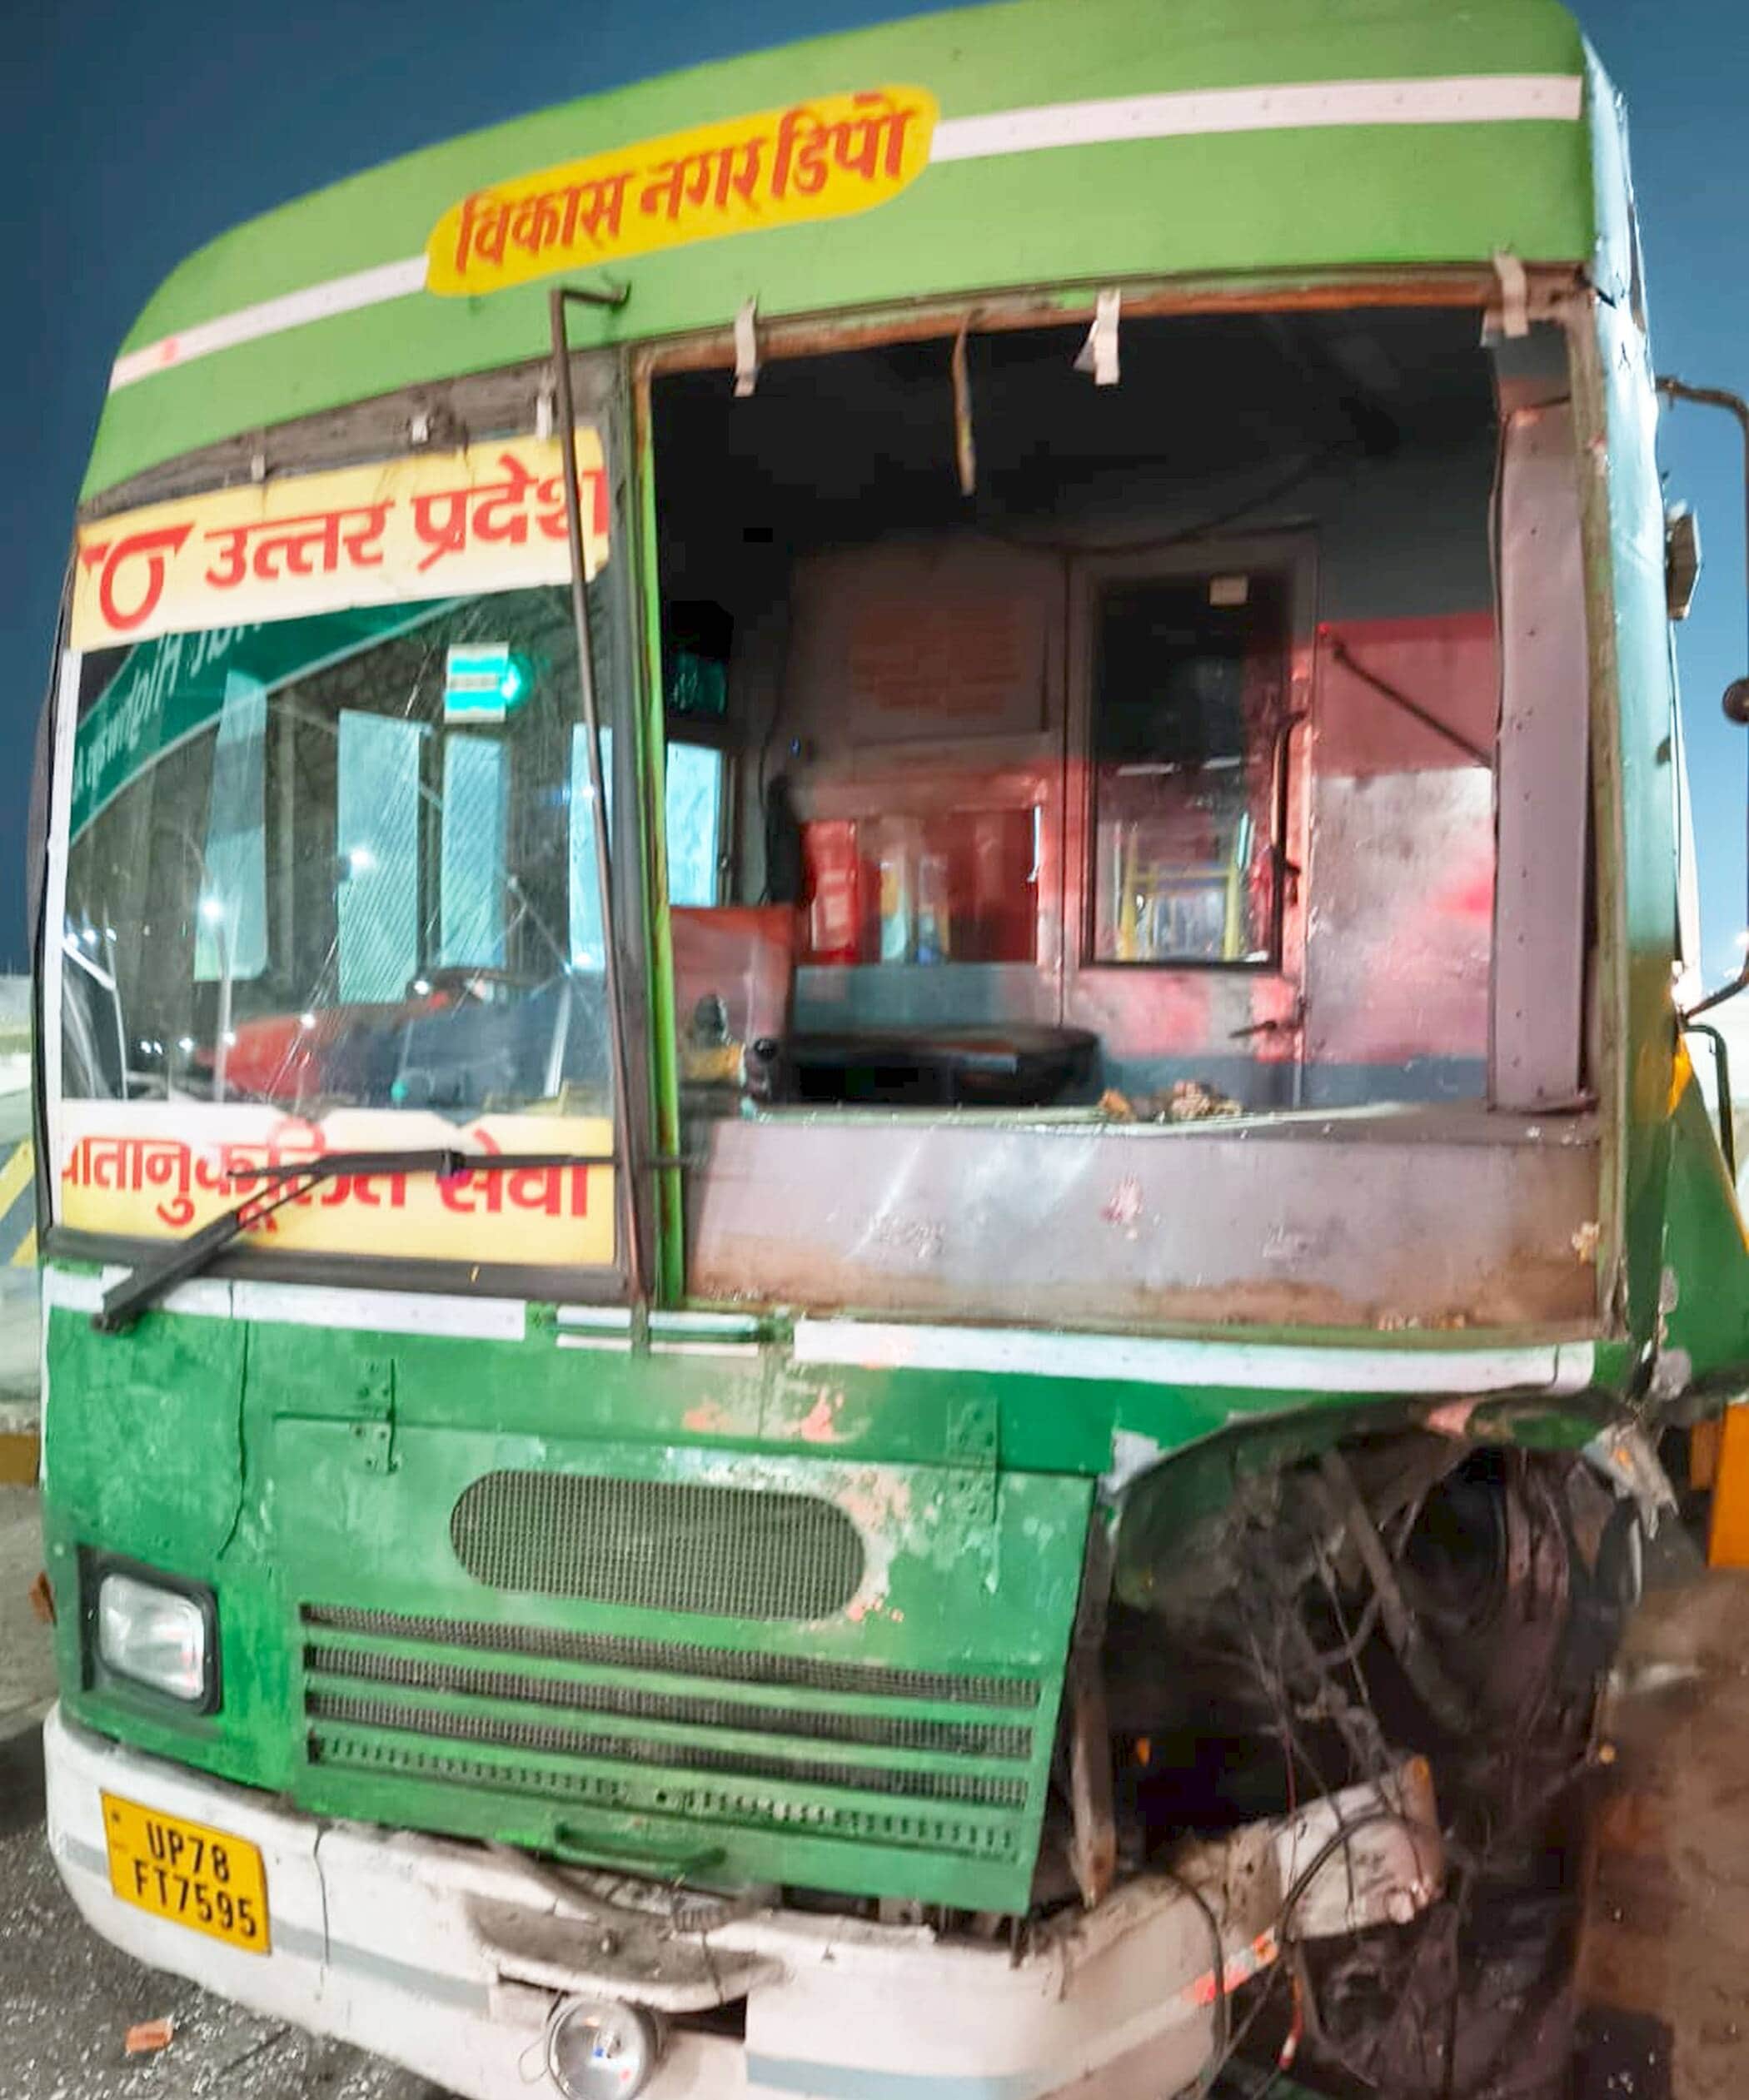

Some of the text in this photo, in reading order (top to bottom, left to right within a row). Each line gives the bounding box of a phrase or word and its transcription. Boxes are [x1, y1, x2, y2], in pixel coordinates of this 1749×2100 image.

[455, 92, 917, 276] विकास नगर डिपो
[203, 498, 396, 590] उत्तर
[435, 1128, 590, 1217] सेवा
[146, 1821, 231, 1884] UP78
[133, 1858, 257, 1938] FT7595
